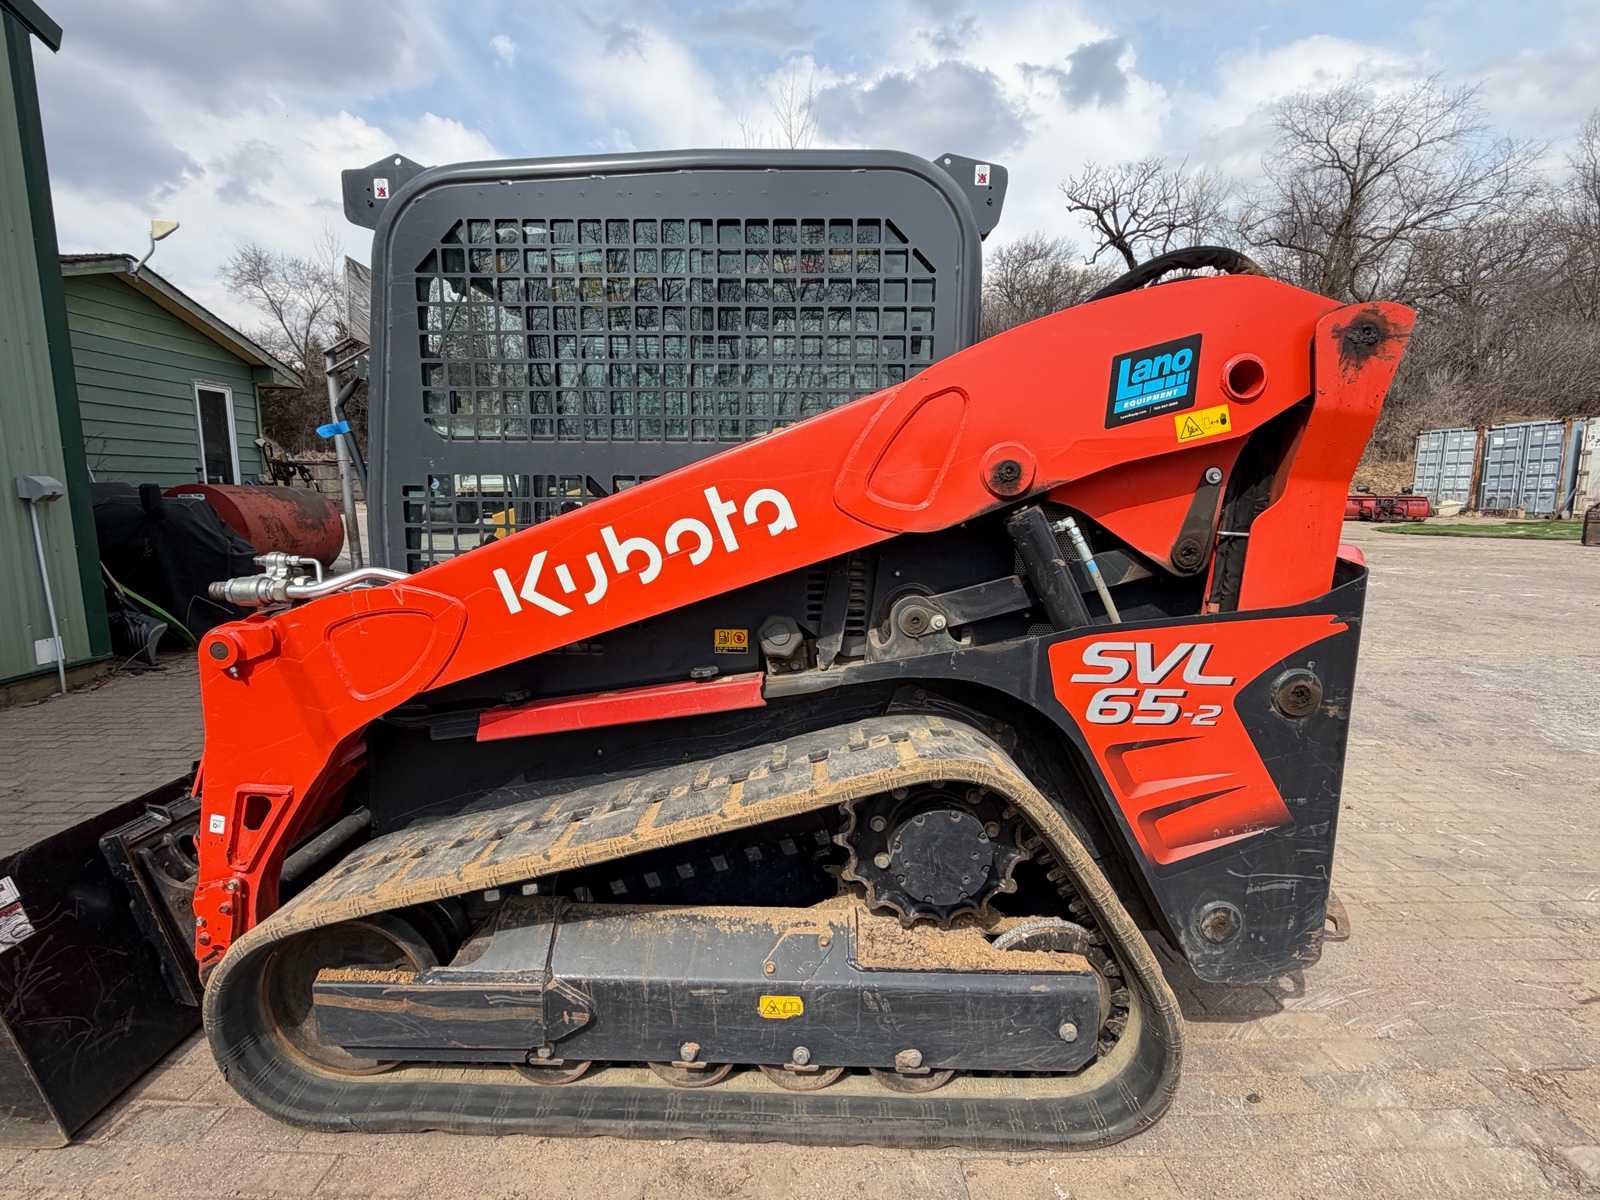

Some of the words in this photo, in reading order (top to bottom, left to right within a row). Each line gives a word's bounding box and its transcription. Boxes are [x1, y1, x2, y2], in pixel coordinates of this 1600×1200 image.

[1116, 348, 1193, 401] Lano
[1123, 388, 1179, 408] EQUIPMENT
[492, 485, 798, 617] Kubota
[1070, 641, 1237, 686] SVL
[1085, 687, 1224, 726] 65-2
